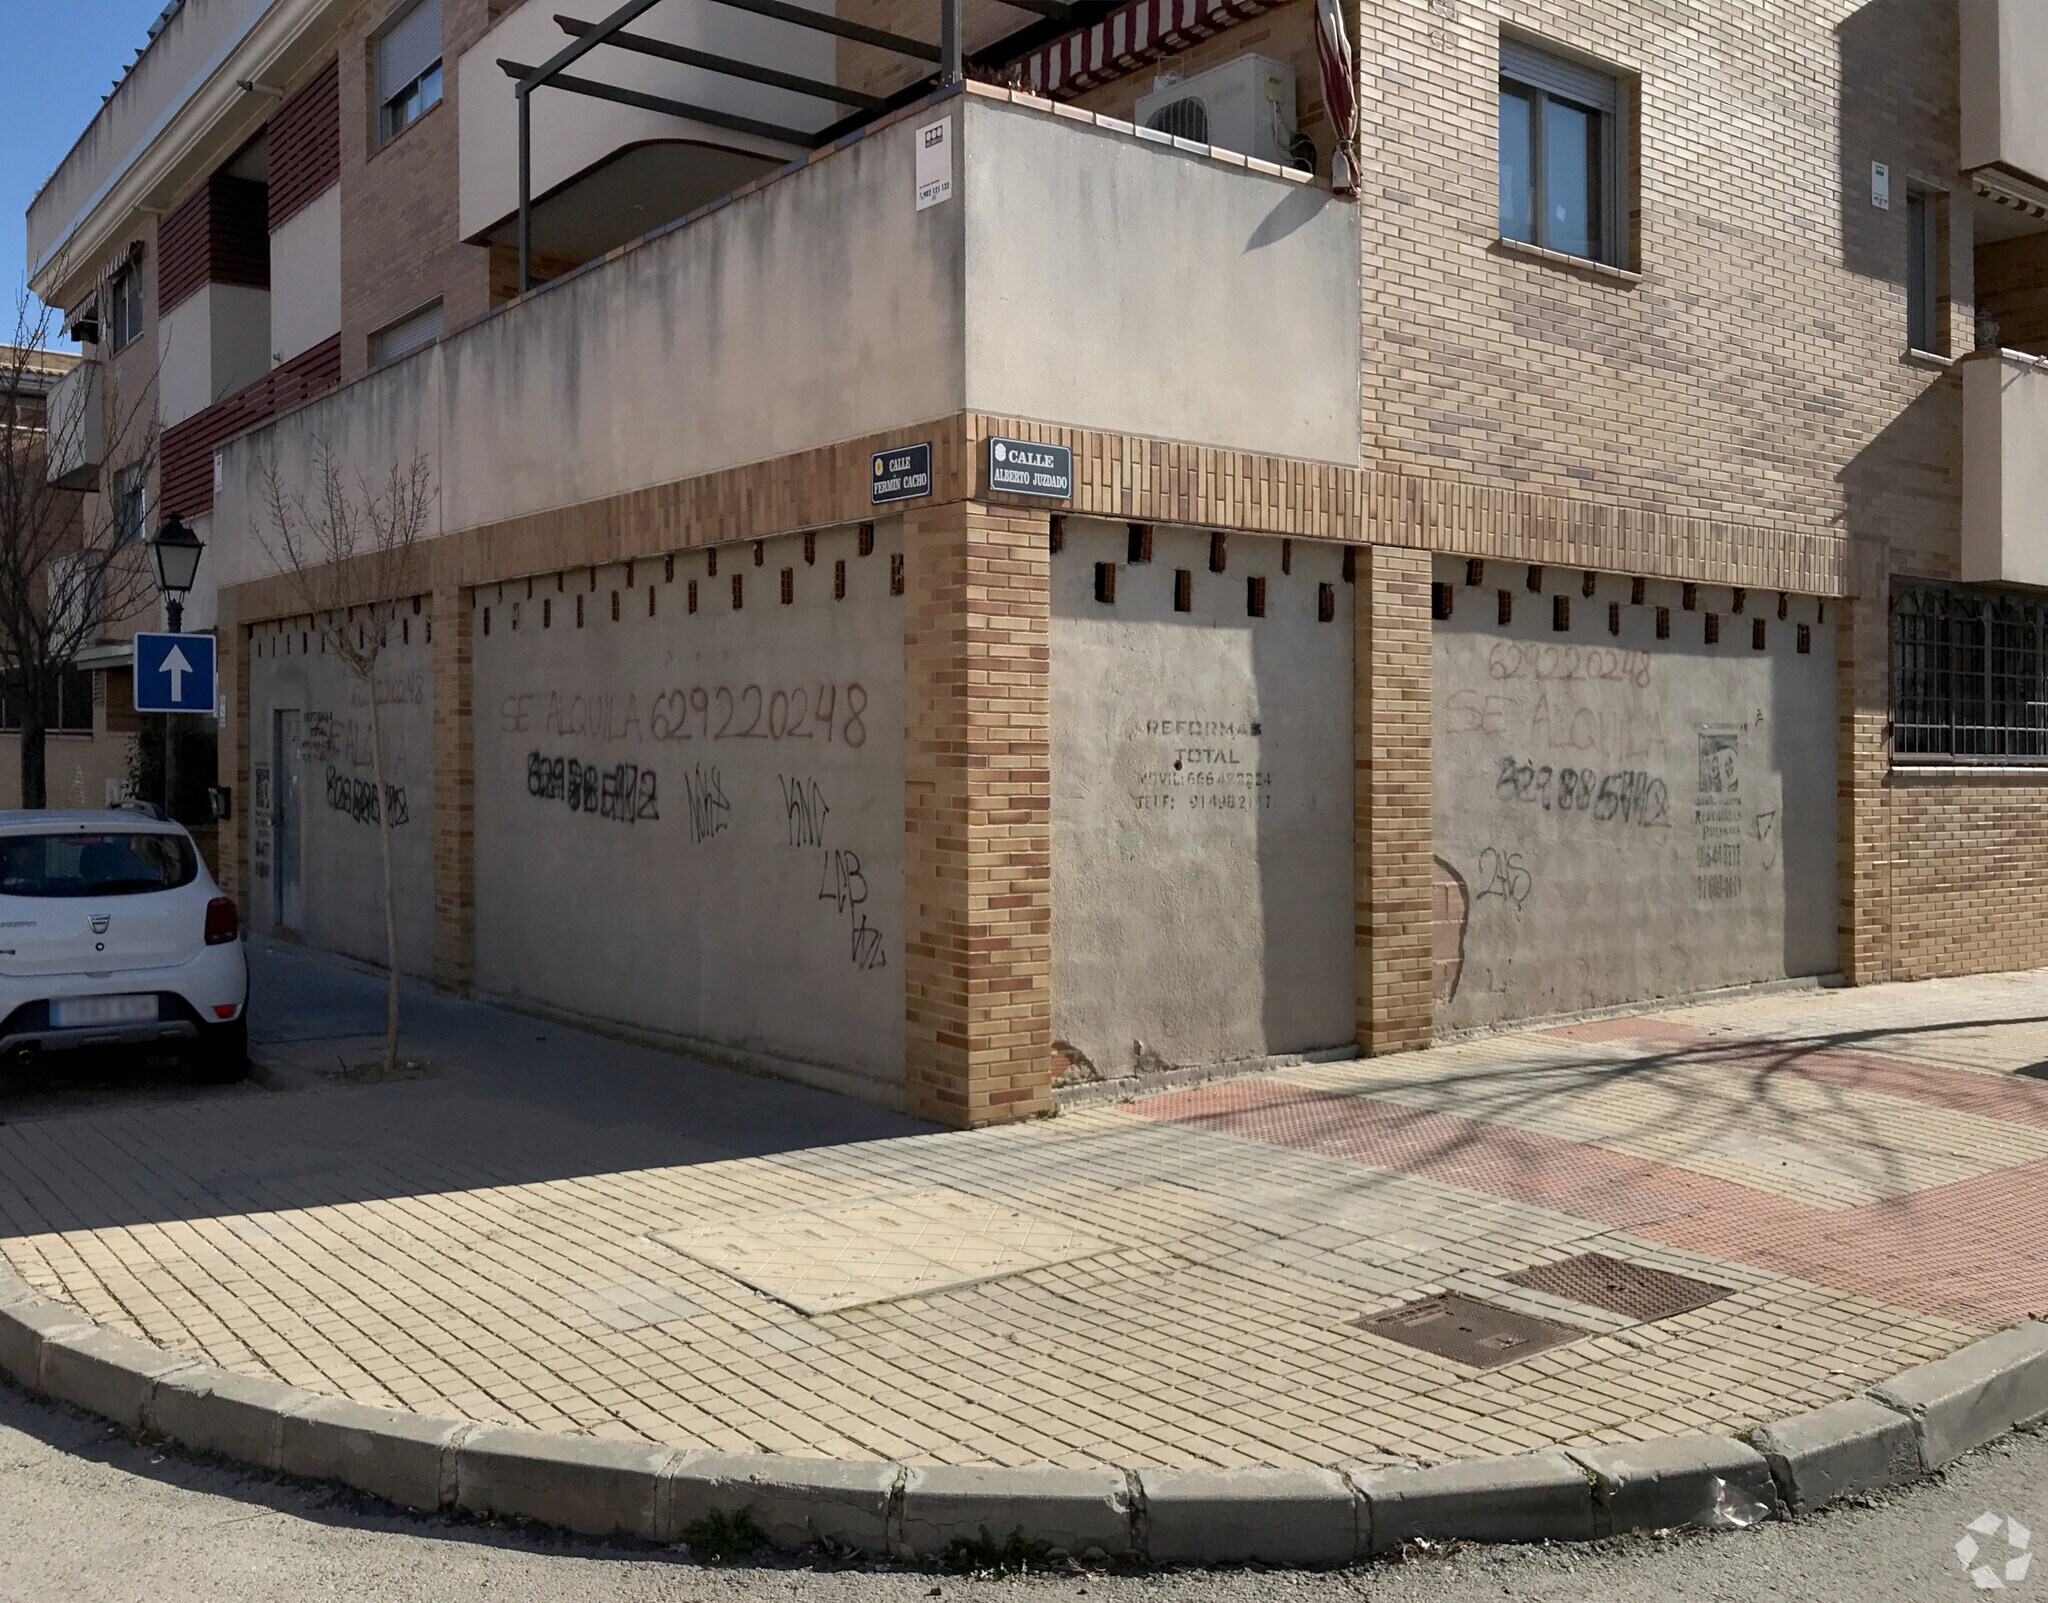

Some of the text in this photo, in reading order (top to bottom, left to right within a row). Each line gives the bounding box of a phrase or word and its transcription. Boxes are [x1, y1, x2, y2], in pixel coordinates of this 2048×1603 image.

[889, 456, 911, 472] CALLE
[1008, 450, 1054, 468] CALLE
[873, 473, 927, 495] FERMÍN CACHO
[994, 468, 1068, 489] ALBERTO JUZDADO
[651, 683, 868, 748] 629220248
[1174, 748, 1240, 764] TOTAL
